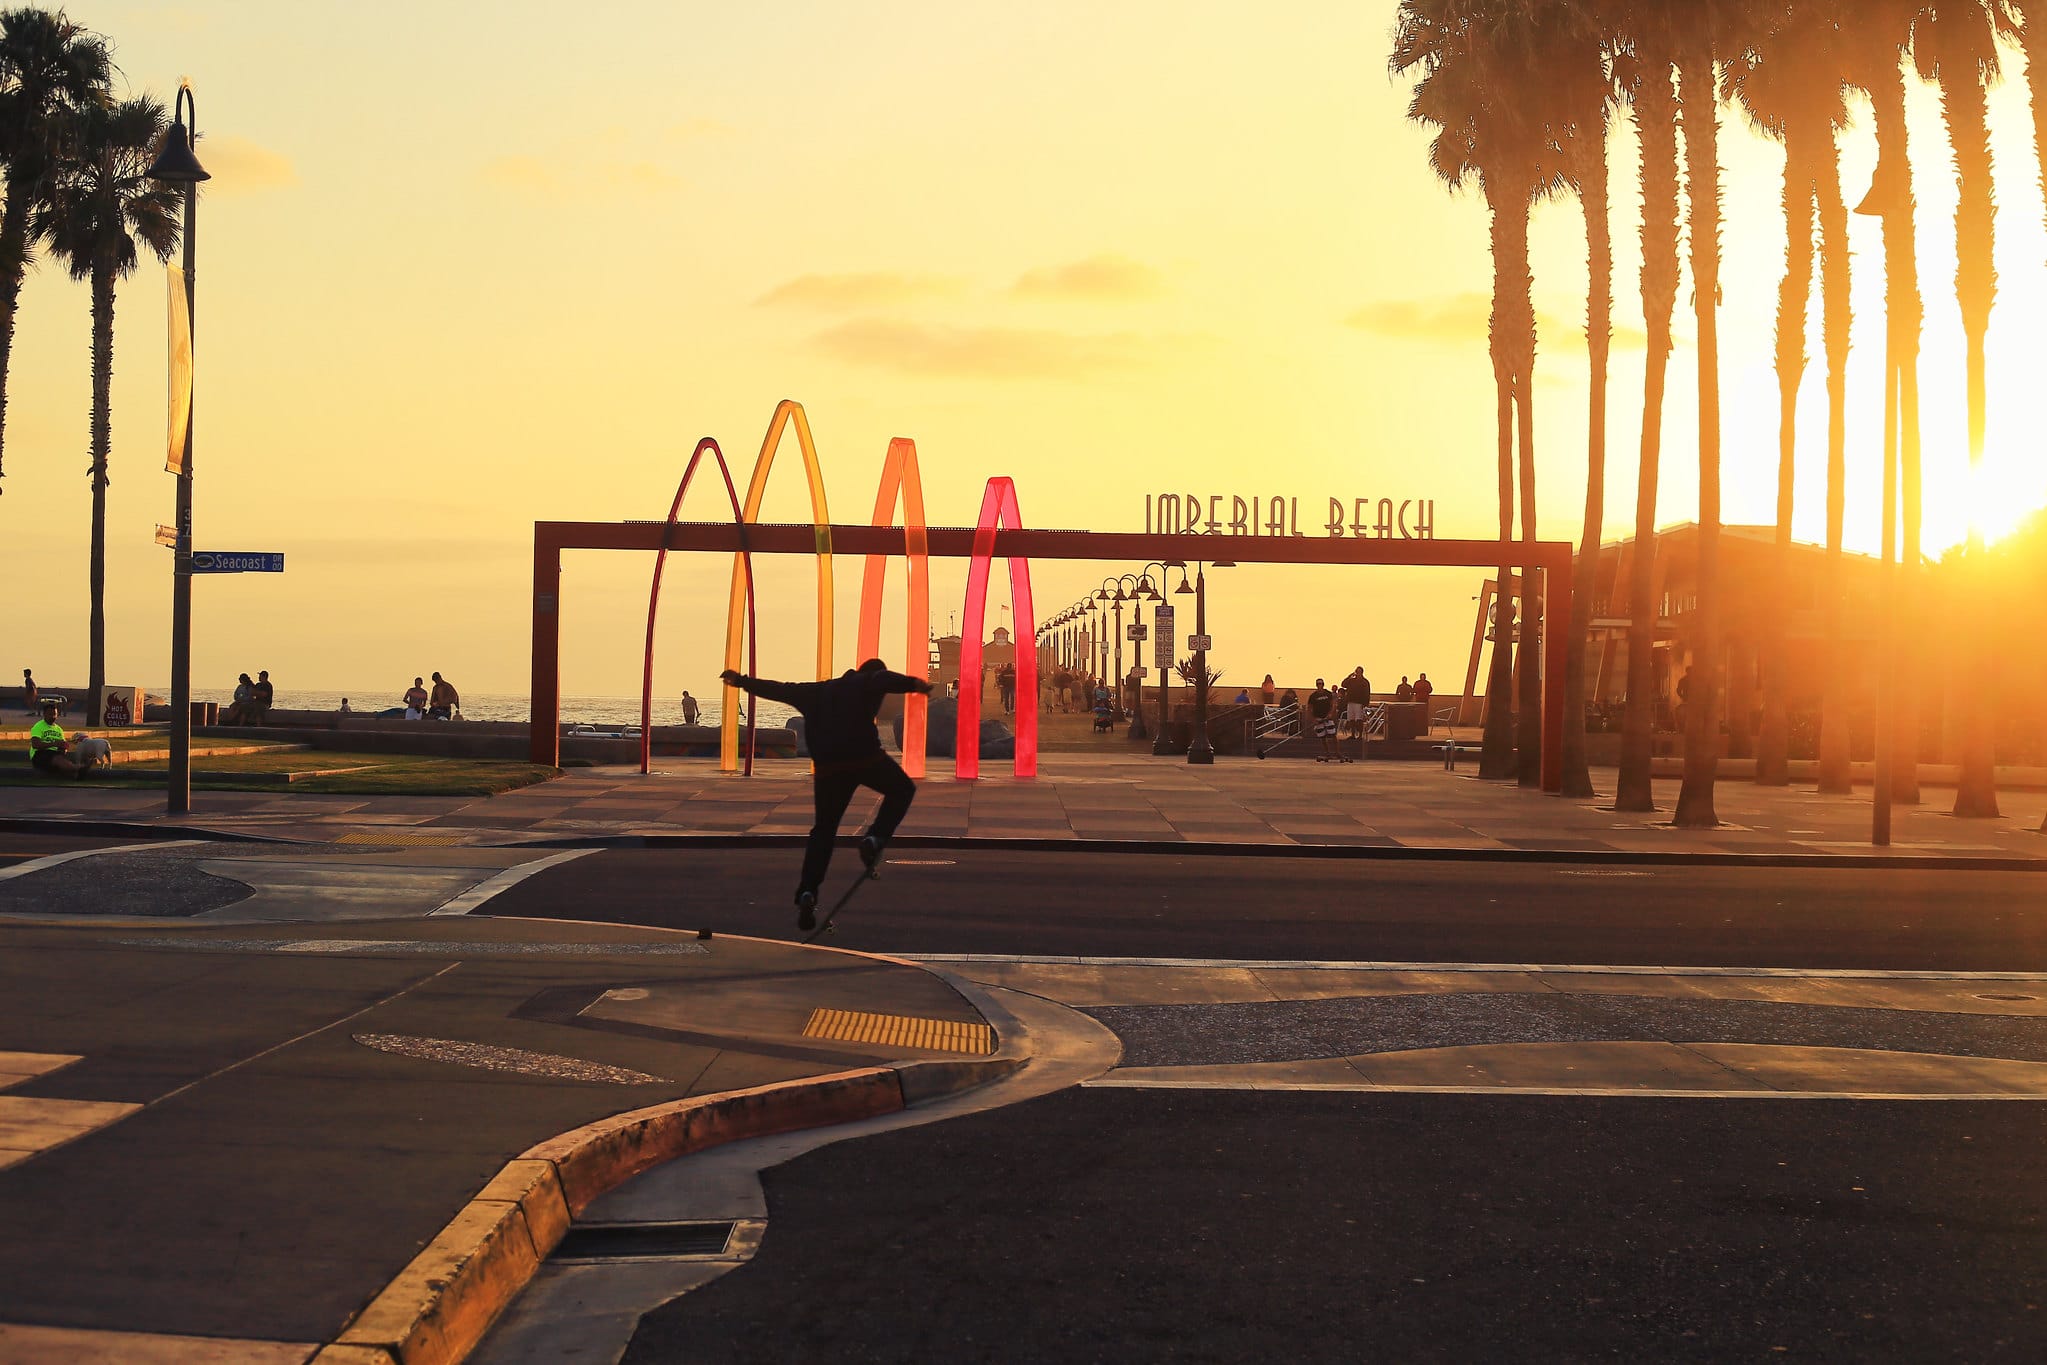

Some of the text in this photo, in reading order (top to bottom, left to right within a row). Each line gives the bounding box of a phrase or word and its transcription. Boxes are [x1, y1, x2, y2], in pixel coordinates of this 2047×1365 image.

[1146, 494, 1433, 540] IMPERIAL BEACH
[215, 554, 283, 569] Seacoast DR
[106, 712, 128, 720] COALS
